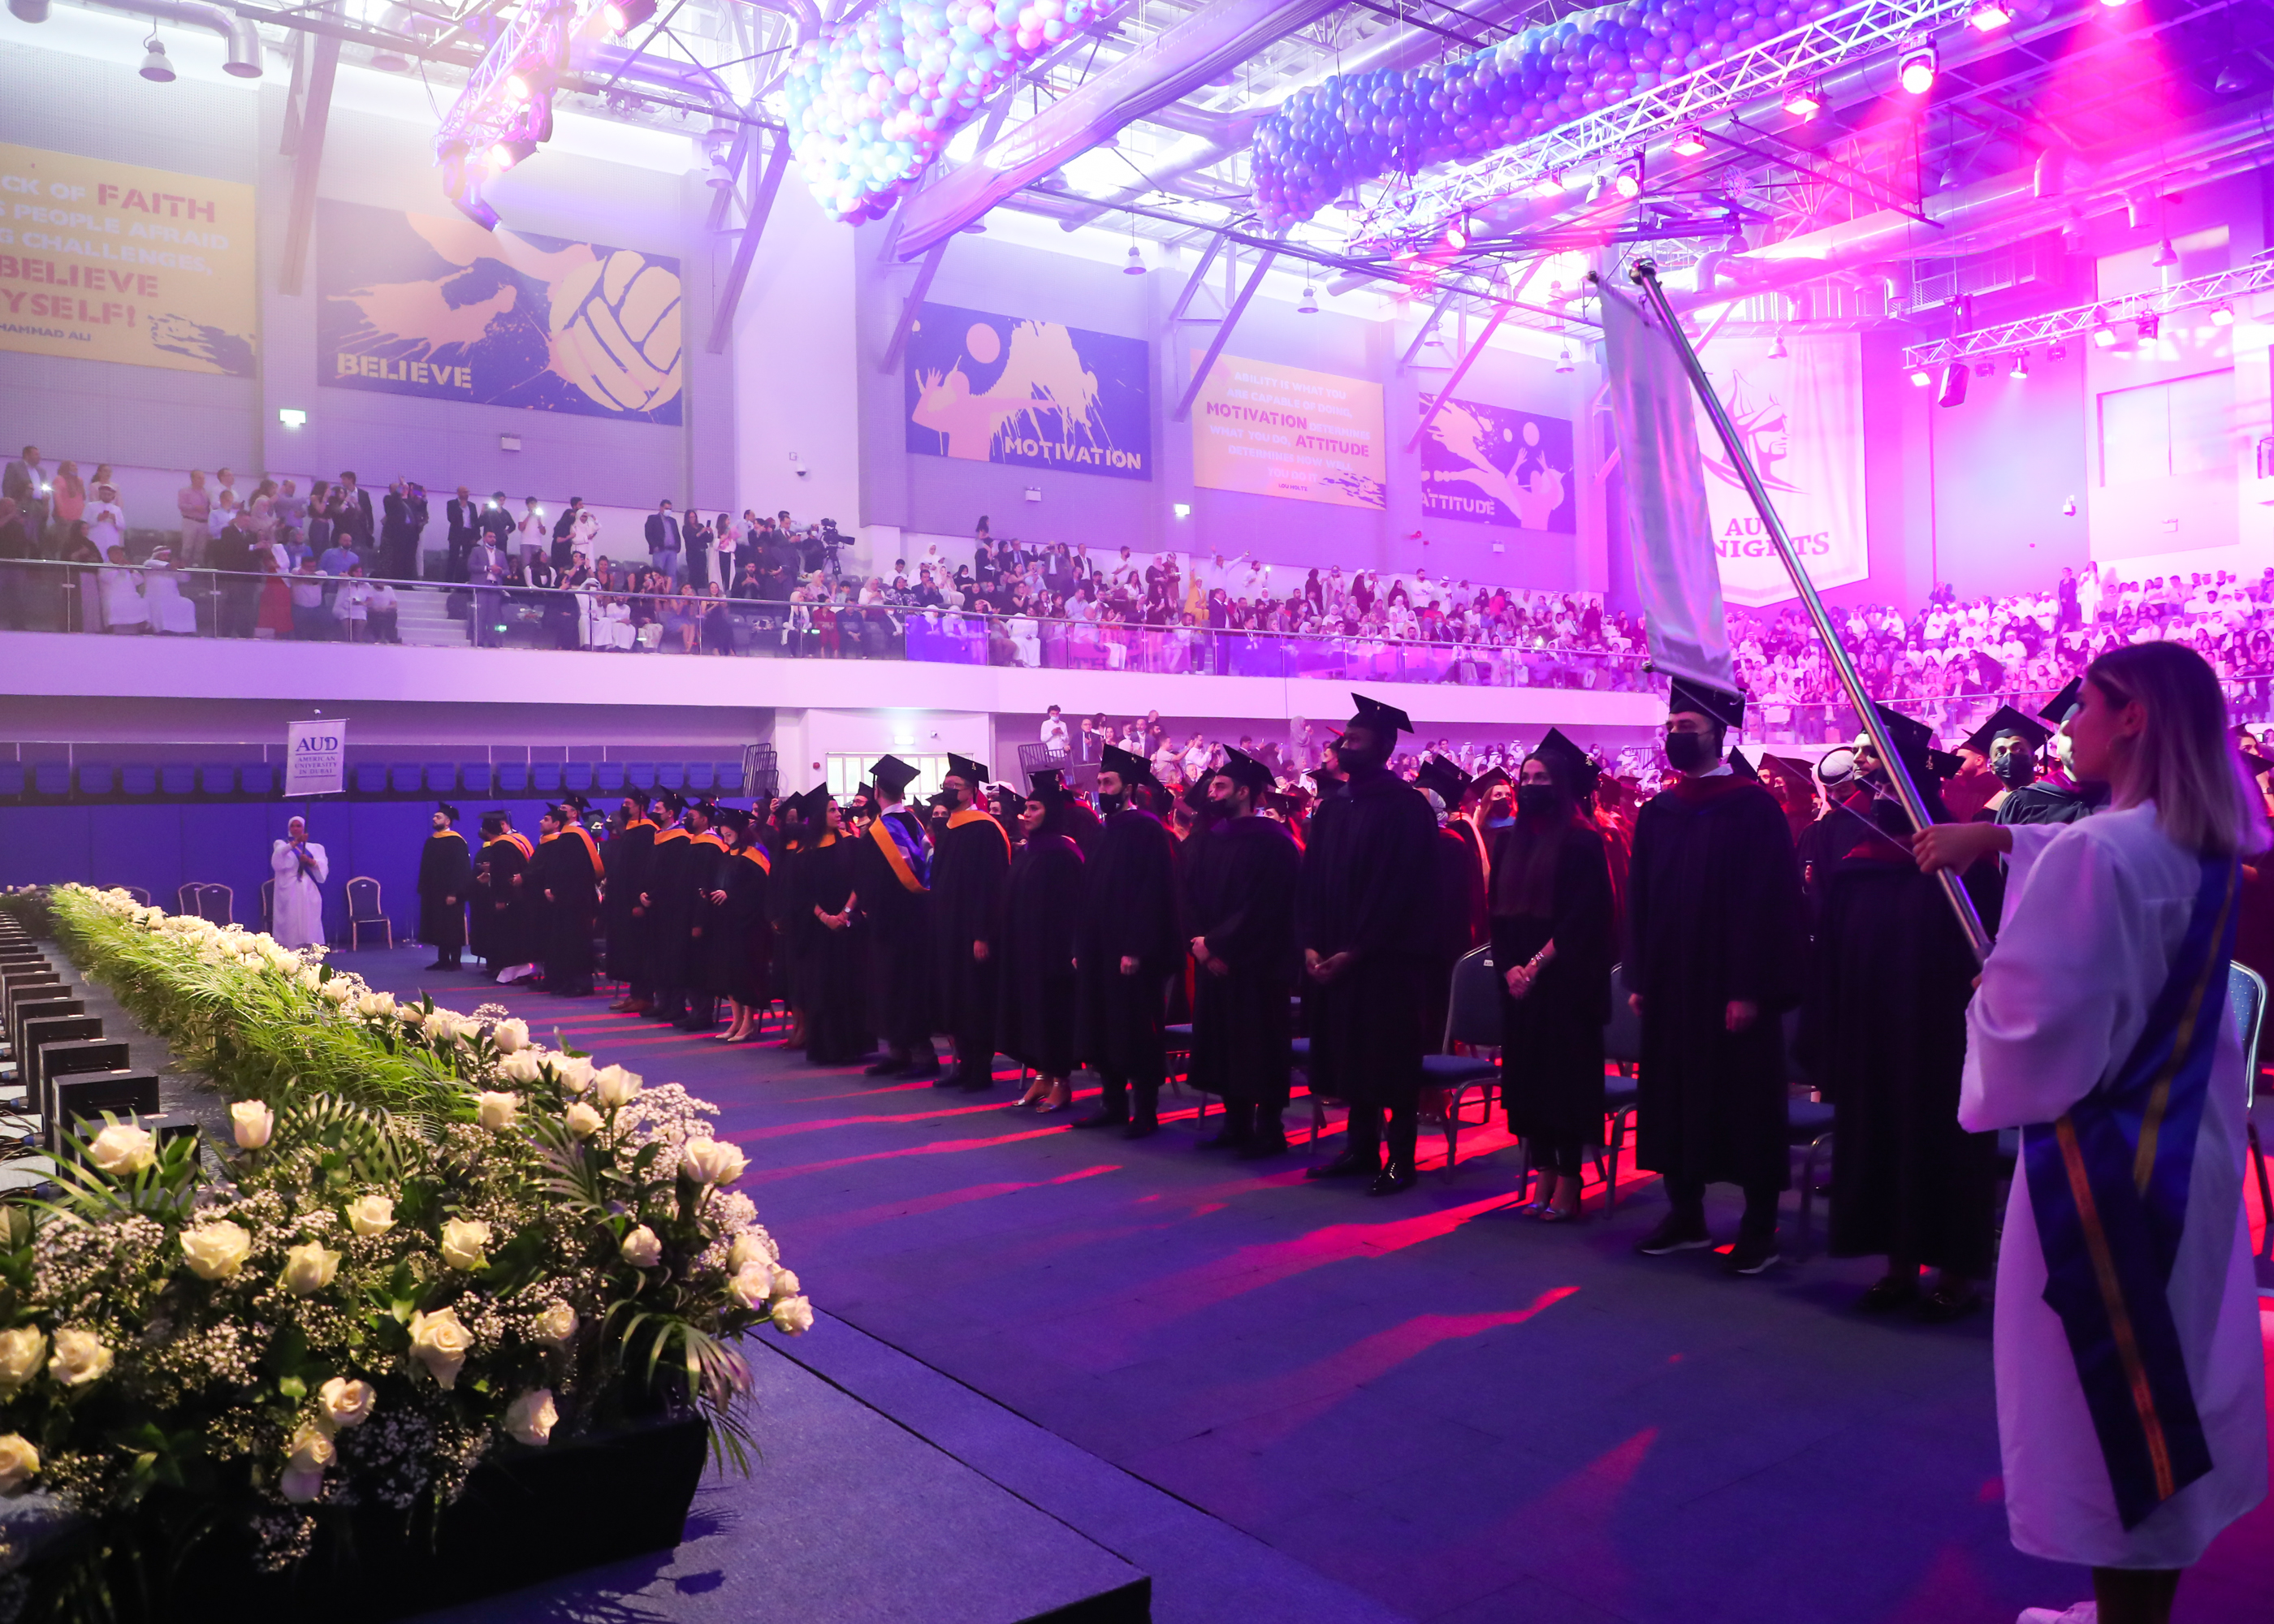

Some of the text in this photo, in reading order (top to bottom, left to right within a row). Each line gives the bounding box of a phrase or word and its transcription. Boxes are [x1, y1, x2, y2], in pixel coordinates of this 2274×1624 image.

[2, 175, 215, 222] CK OF FAITH
[14, 204, 120, 234] PEOPLE
[128, 222, 230, 251] AFRAID
[22, 232, 213, 276] CHALLENGES,
[0, 254, 159, 298] BELIEVE
[0, 287, 136, 328] YSELF!
[68, 331, 91, 342] ALI
[337, 352, 472, 388] BELIEVE
[1227, 388, 1248, 400] ARE
[1251, 392, 1300, 408] CAPABLE
[1303, 400, 1316, 411] OF
[1234, 372, 1347, 400] ABILITY IS WHAT YOU
[1207, 401, 1371, 440] MOTIVATION DETERMINES
[1005, 436, 1141, 469] MOTIVATION
[1210, 425, 1369, 457] WHAT YOU DO, ATTITUDE
[1228, 445, 1295, 463] DETERMINES
[1297, 455, 1322, 467] HOW
[1268, 467, 1318, 482] YOU DO IT
[1422, 492, 1495, 516] ATTITUDE
[1724, 517, 1783, 536] AU
[1714, 531, 1830, 558] NIGTS
[295, 736, 338, 752] AUD
